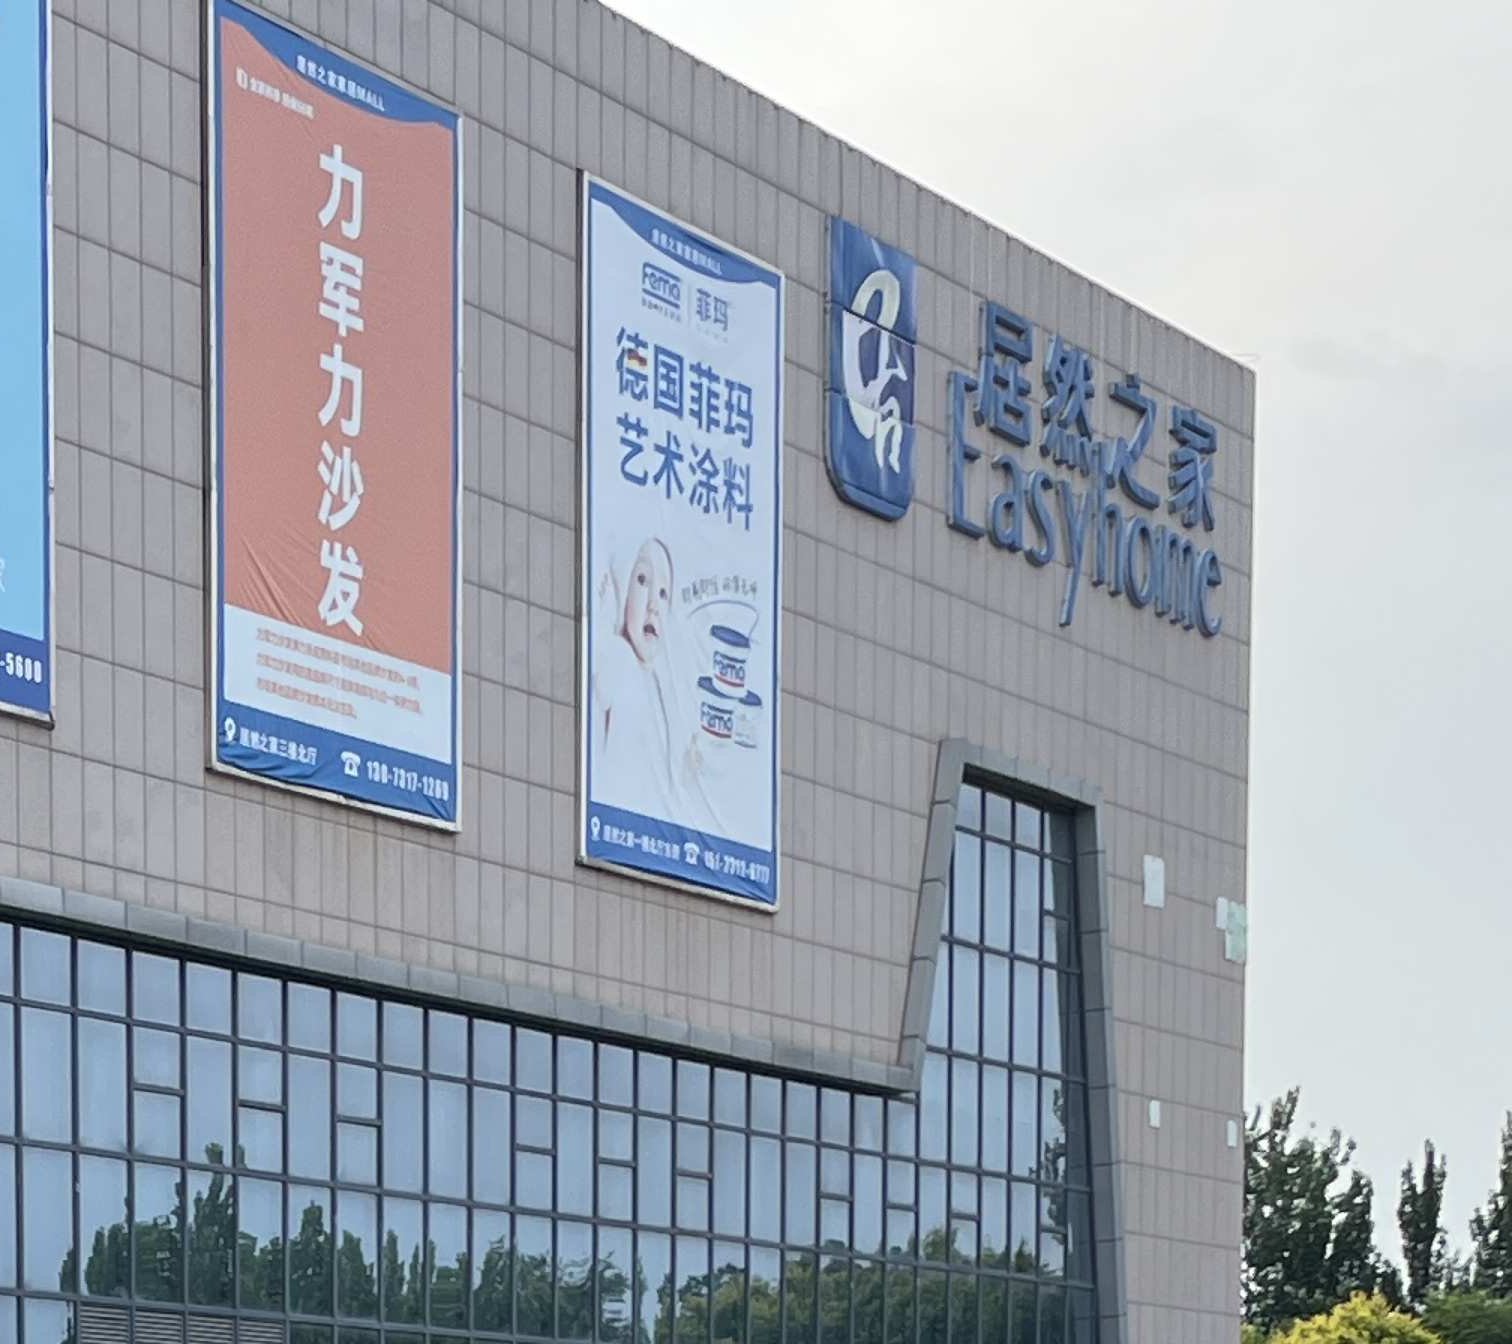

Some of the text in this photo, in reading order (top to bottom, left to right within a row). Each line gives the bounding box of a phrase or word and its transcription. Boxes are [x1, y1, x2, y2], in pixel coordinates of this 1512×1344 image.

[317, 143, 364, 637] 力军力沙发
[616, 327, 753, 449] 德国菲玛
[616, 412, 754, 532] 艺术涂料
[946, 370, 1223, 638] Easyhome
[972, 299, 1218, 532] 居然之家
